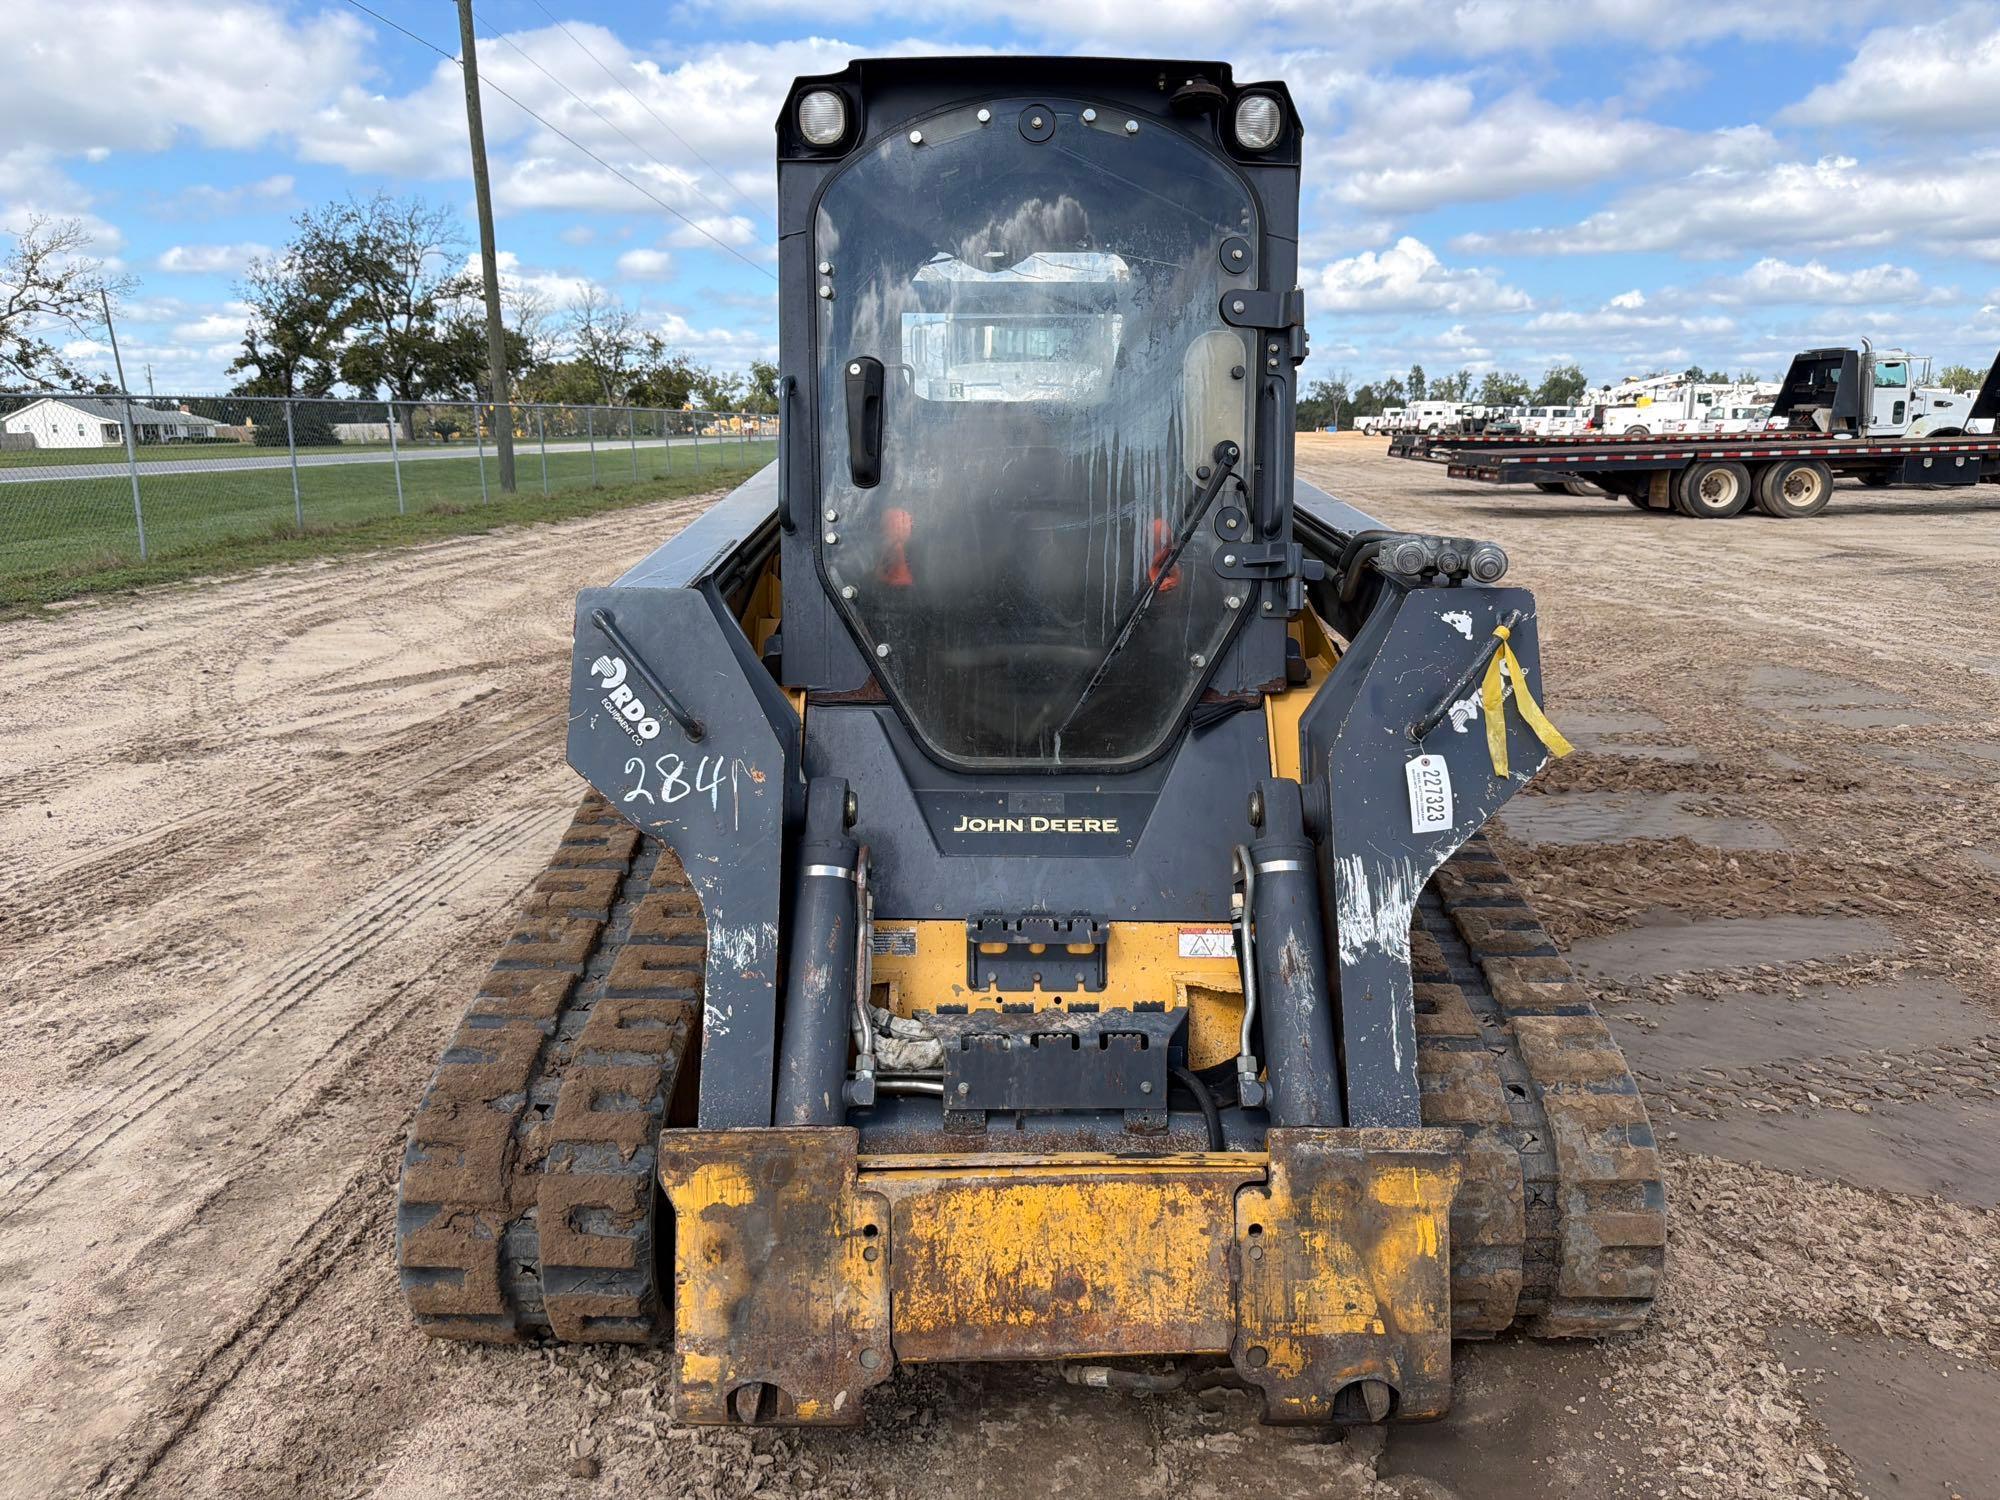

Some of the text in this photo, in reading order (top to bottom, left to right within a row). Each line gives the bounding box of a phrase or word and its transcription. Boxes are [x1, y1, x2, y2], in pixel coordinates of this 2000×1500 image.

[601, 698, 643, 746] EQUIPMENT CO
[608, 683, 660, 740] RDO
[1422, 769, 1446, 822] 227323
[953, 815, 1120, 833] JOHN DEERE
